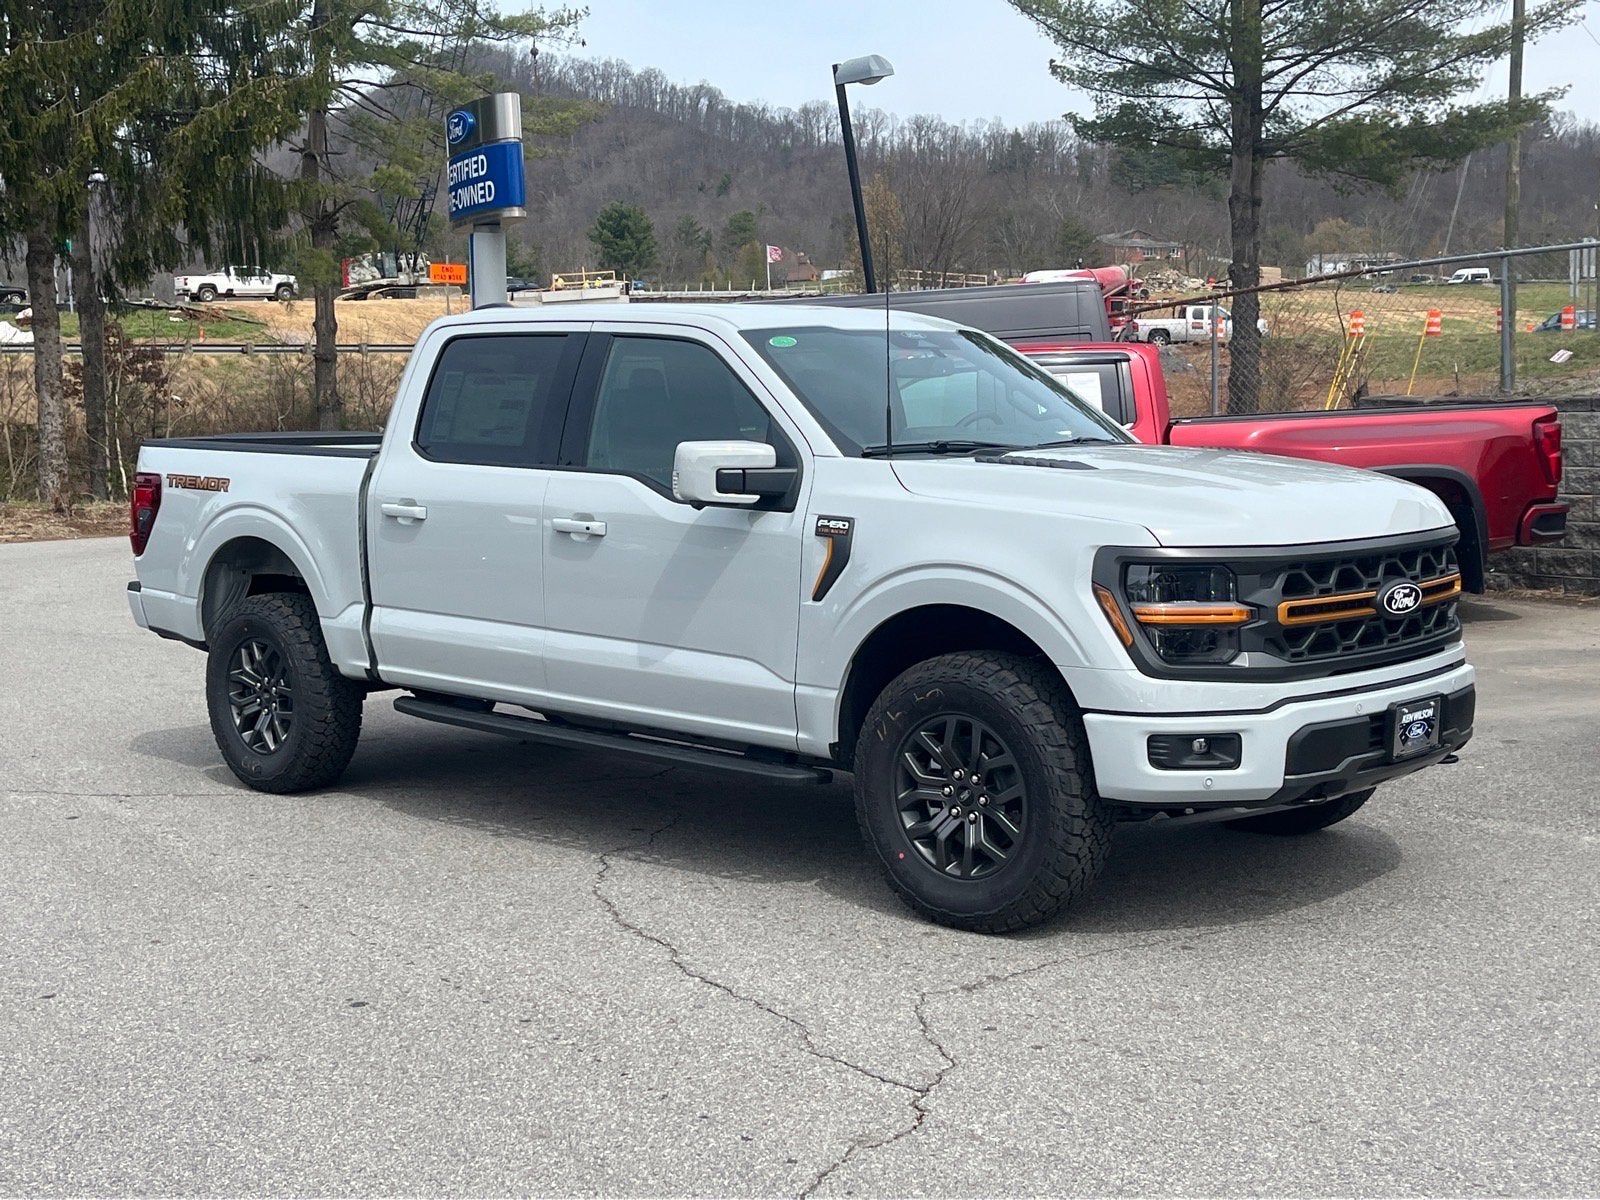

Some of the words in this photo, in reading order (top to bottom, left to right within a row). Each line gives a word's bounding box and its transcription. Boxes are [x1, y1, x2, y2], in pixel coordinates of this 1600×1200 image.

[449, 117, 463, 140] Ford
[449, 154, 487, 186] ERTIFIED
[166, 473, 230, 492] TREMOR
[1391, 588, 1415, 610] Ford
